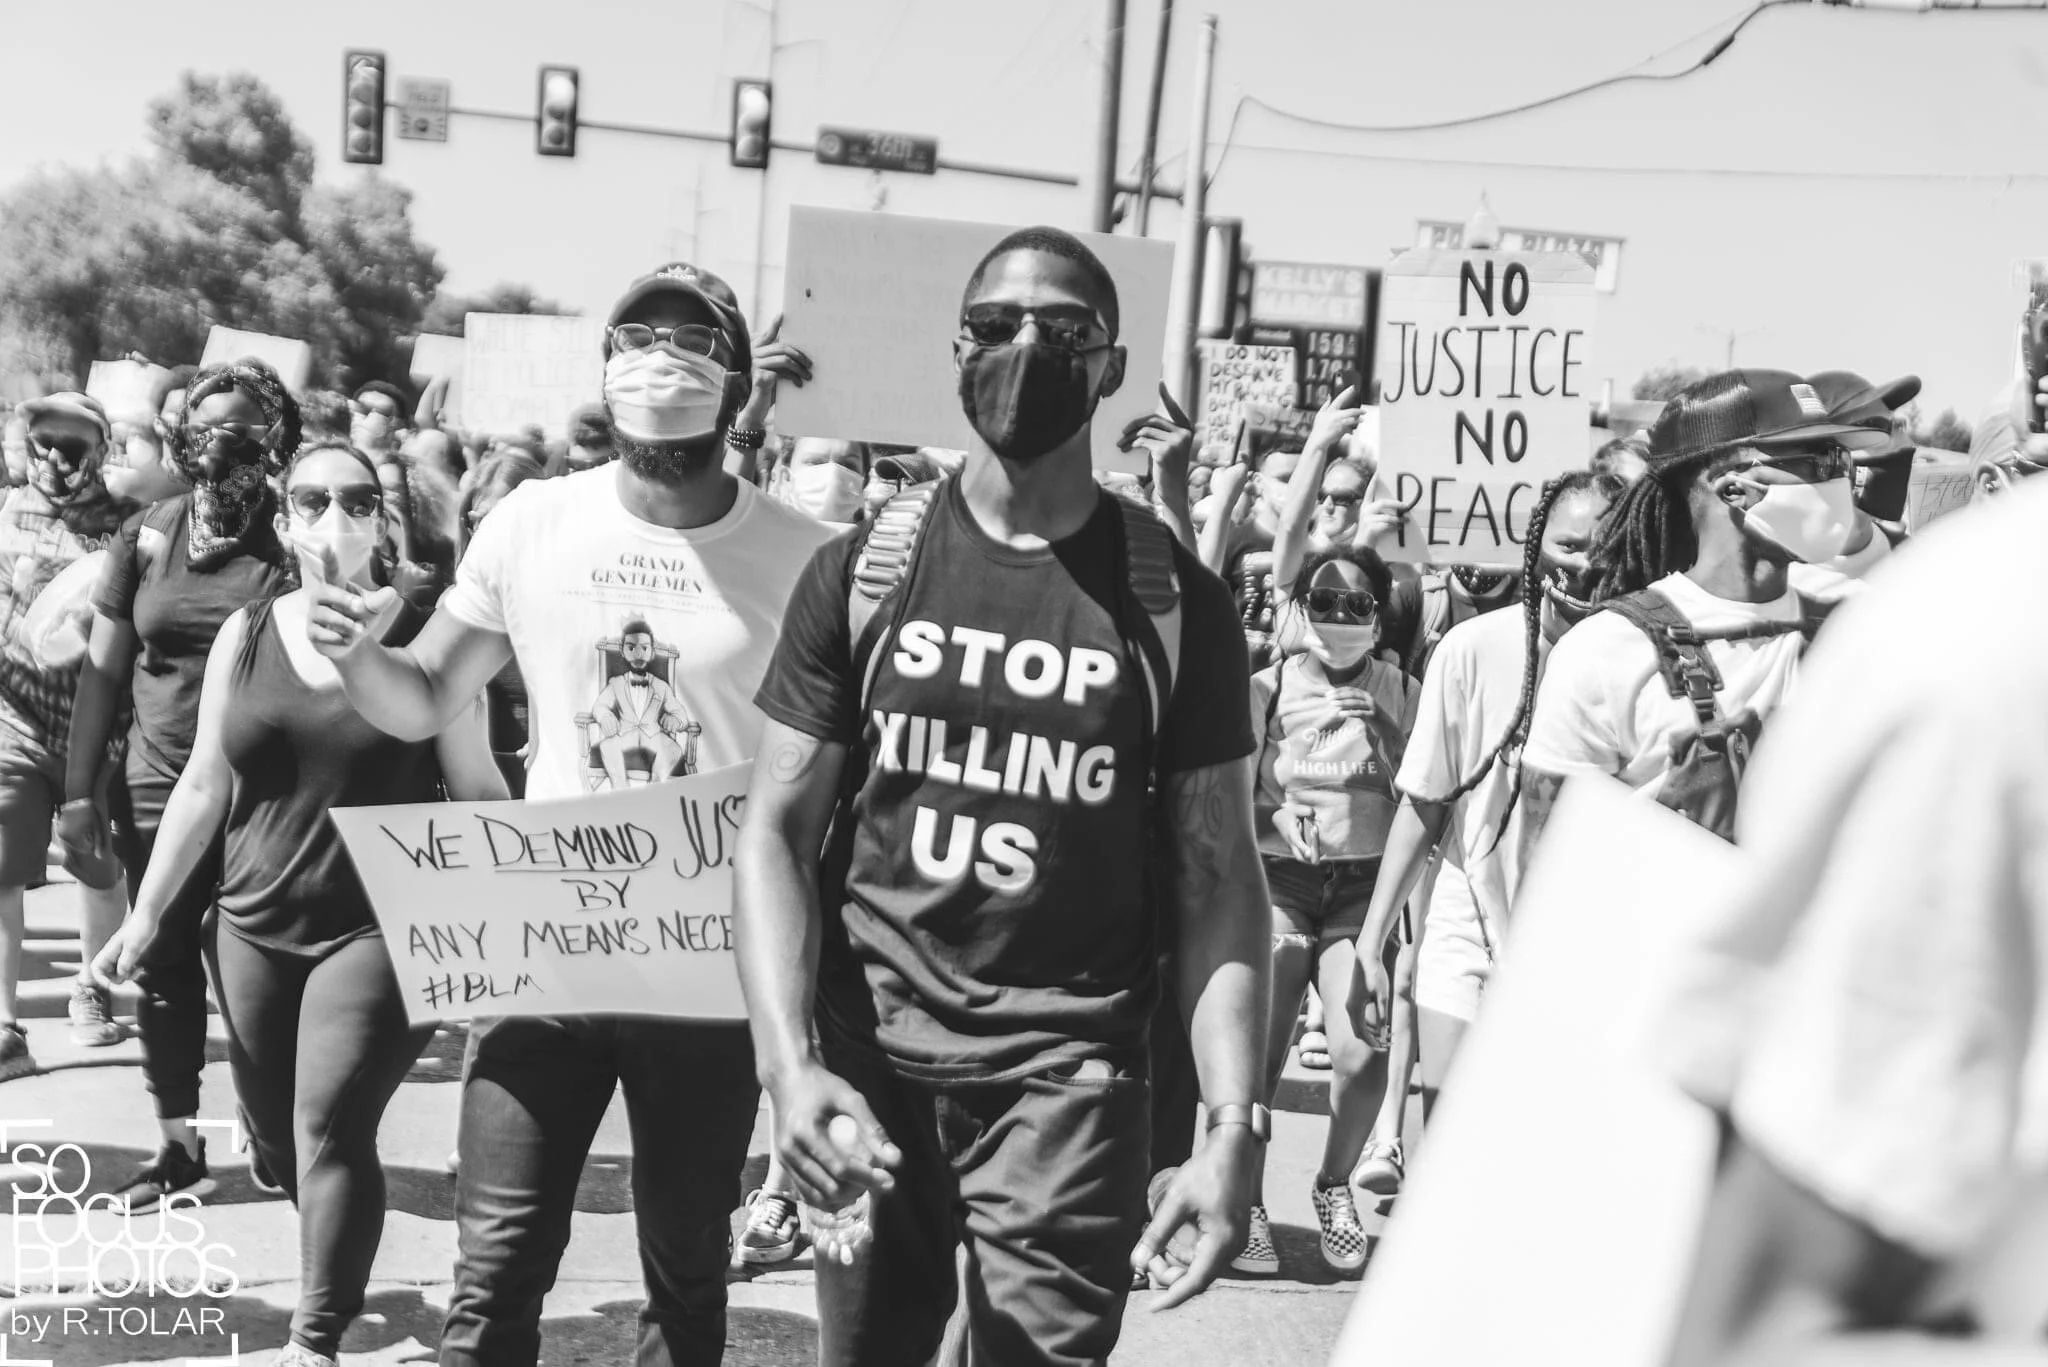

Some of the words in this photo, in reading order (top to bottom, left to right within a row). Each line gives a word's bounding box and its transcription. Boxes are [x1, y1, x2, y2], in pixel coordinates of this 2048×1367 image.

[1459, 260, 1529, 316] NO
[1225, 346, 1248, 360] DO
[1255, 347, 1292, 363] NOT
[1384, 322, 1584, 402] JUSTICE
[1455, 408, 1528, 465] NO
[1397, 472, 1533, 547] PEAC
[591, 568, 704, 594] GENTLEMEN
[619, 552, 685, 573] GRAND
[893, 619, 1118, 705] STOP
[873, 710, 1117, 805] KILLING
[379, 818, 468, 870] WE
[474, 814, 658, 870] DEMAND
[674, 795, 747, 879] JUS
[911, 805, 1039, 894] US
[561, 876, 630, 911] BY
[409, 920, 488, 964] ANY
[523, 917, 650, 958] MEANS
[658, 910, 733, 953] NECE
[422, 973, 544, 1009] #BLM
